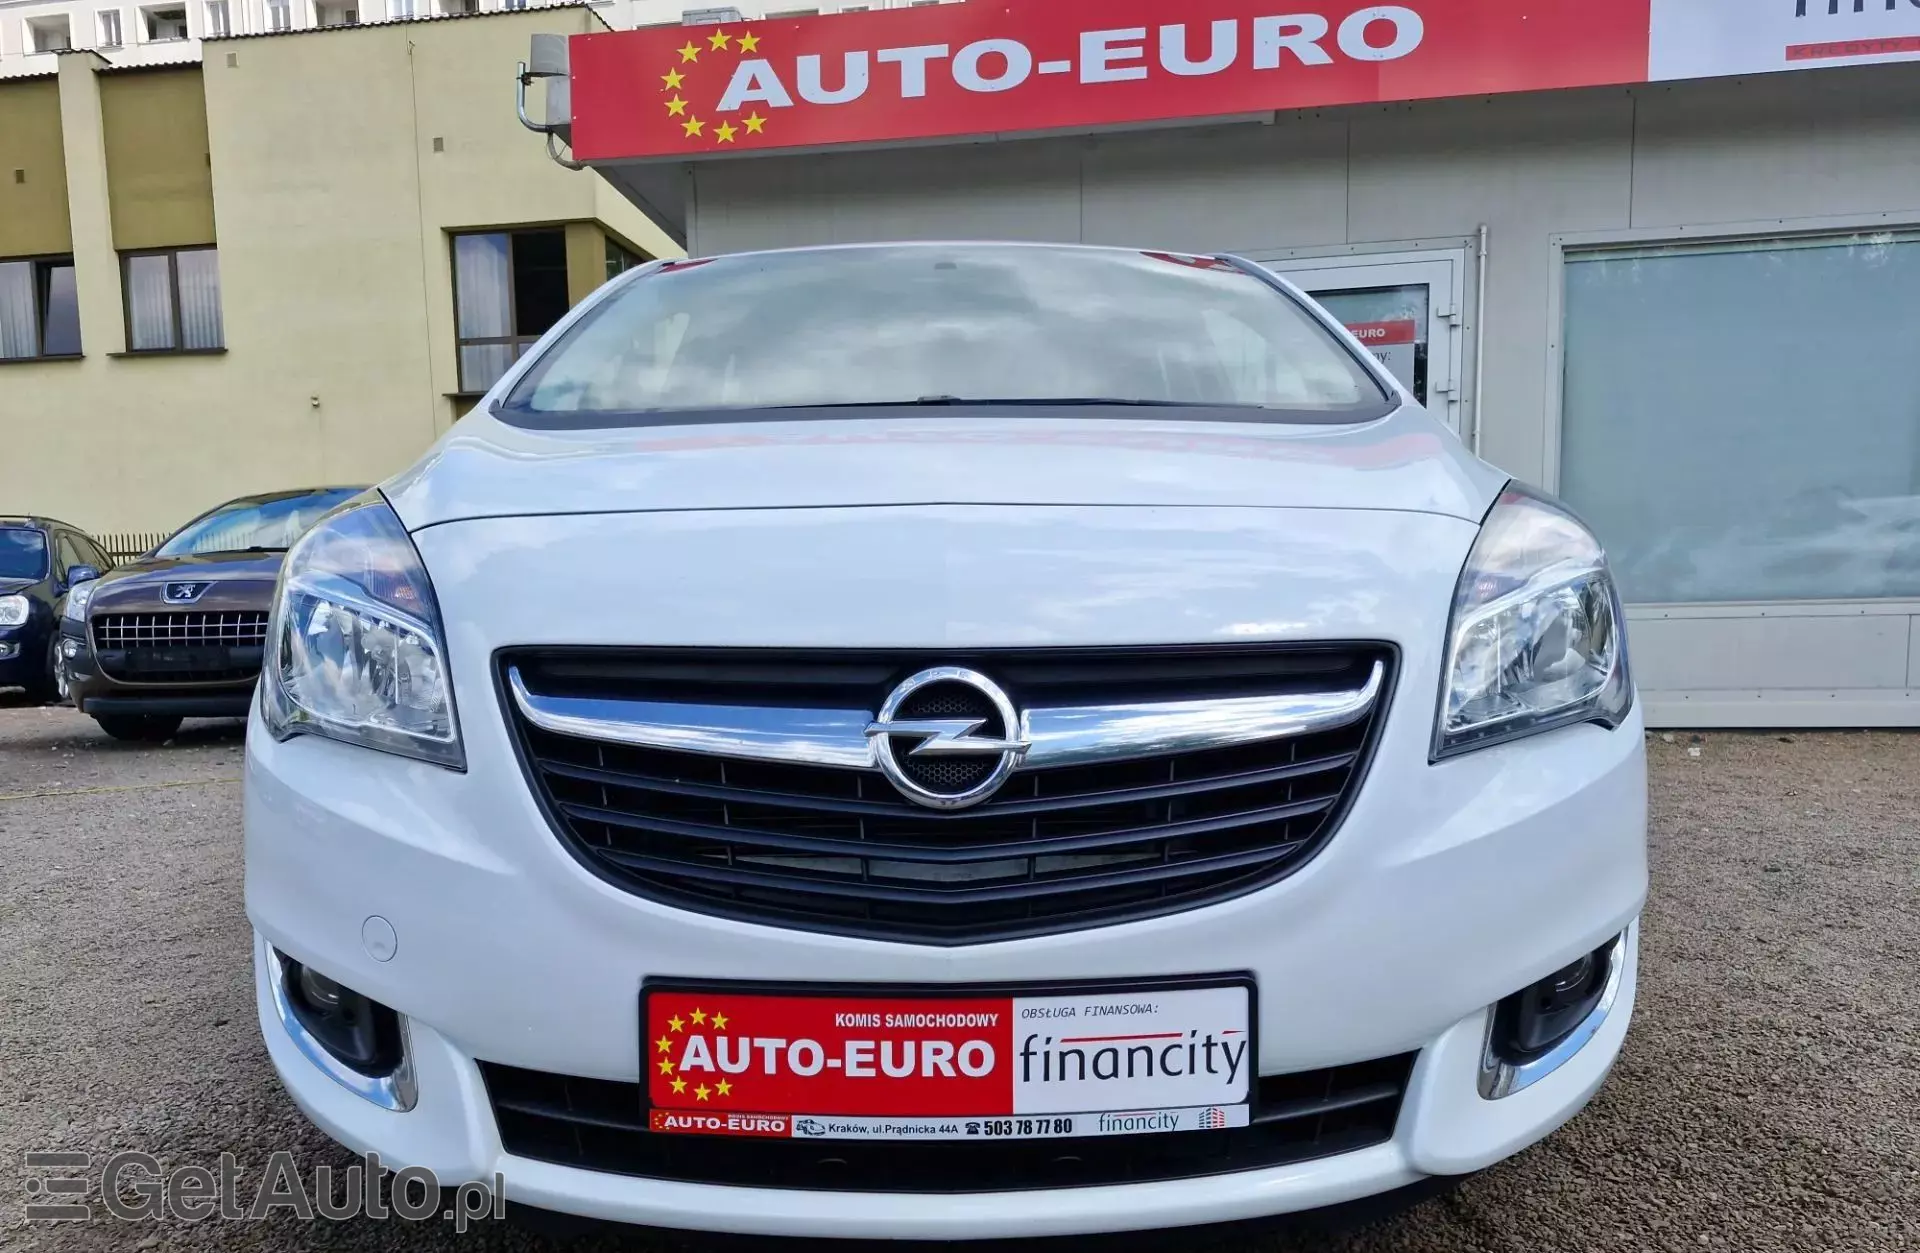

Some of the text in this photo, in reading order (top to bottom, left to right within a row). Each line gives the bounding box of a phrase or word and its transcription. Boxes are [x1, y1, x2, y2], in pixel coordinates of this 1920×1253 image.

[716, 5, 1425, 112] AUTO-EURO
[835, 1013, 999, 1028] KOMIS SAMOCHODOWY
[1021, 1004, 1160, 1019] OBSŁUGA FINANSOWA:
[679, 1035, 996, 1078] AUTO-EURO
[1019, 1029, 1247, 1085] financity
[664, 1116, 785, 1132] AUTO-EURO
[828, 1123, 870, 1135] Kraków,
[938, 1124, 959, 1134] 44A
[984, 1120, 1013, 1136] 503
[1016, 1120, 1033, 1135] 78
[1036, 1120, 1051, 1134] 77
[1053, 1118, 1073, 1133] 80
[1099, 1112, 1179, 1132] financity
